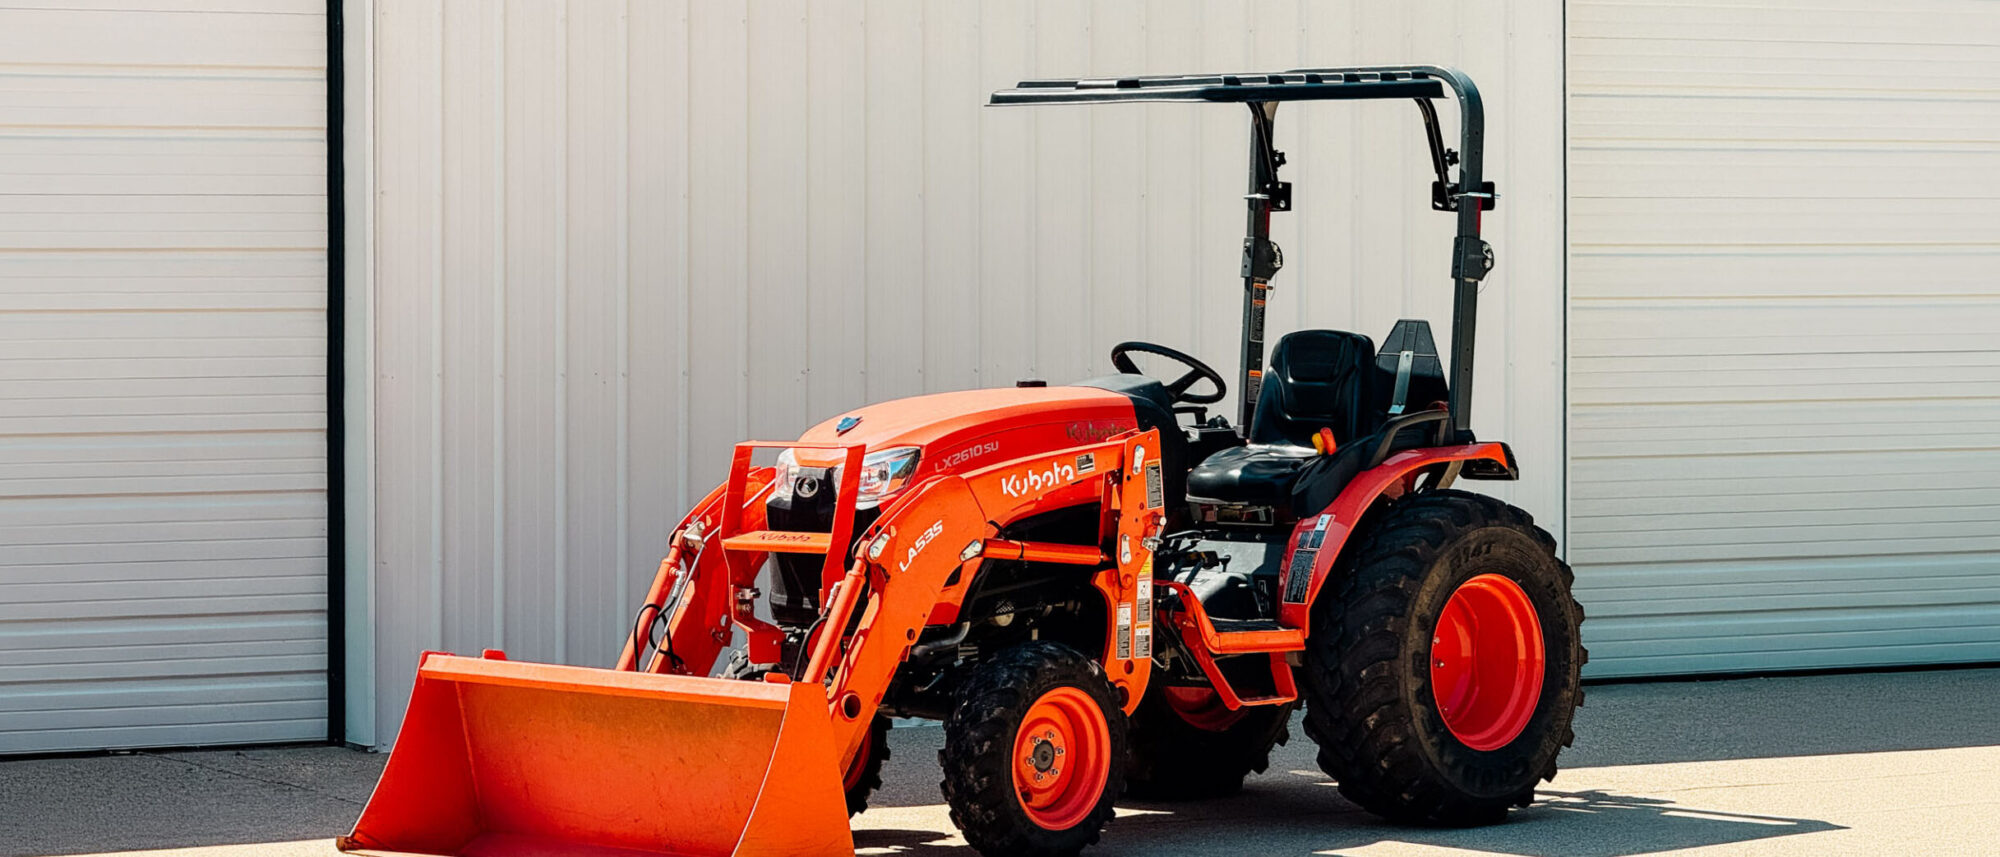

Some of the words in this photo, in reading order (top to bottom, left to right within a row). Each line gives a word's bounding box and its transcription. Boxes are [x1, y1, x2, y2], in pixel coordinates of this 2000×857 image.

[1001, 461, 1074, 498] Kubota
[758, 532, 811, 542] Kubota
[899, 520, 943, 572] LA535
